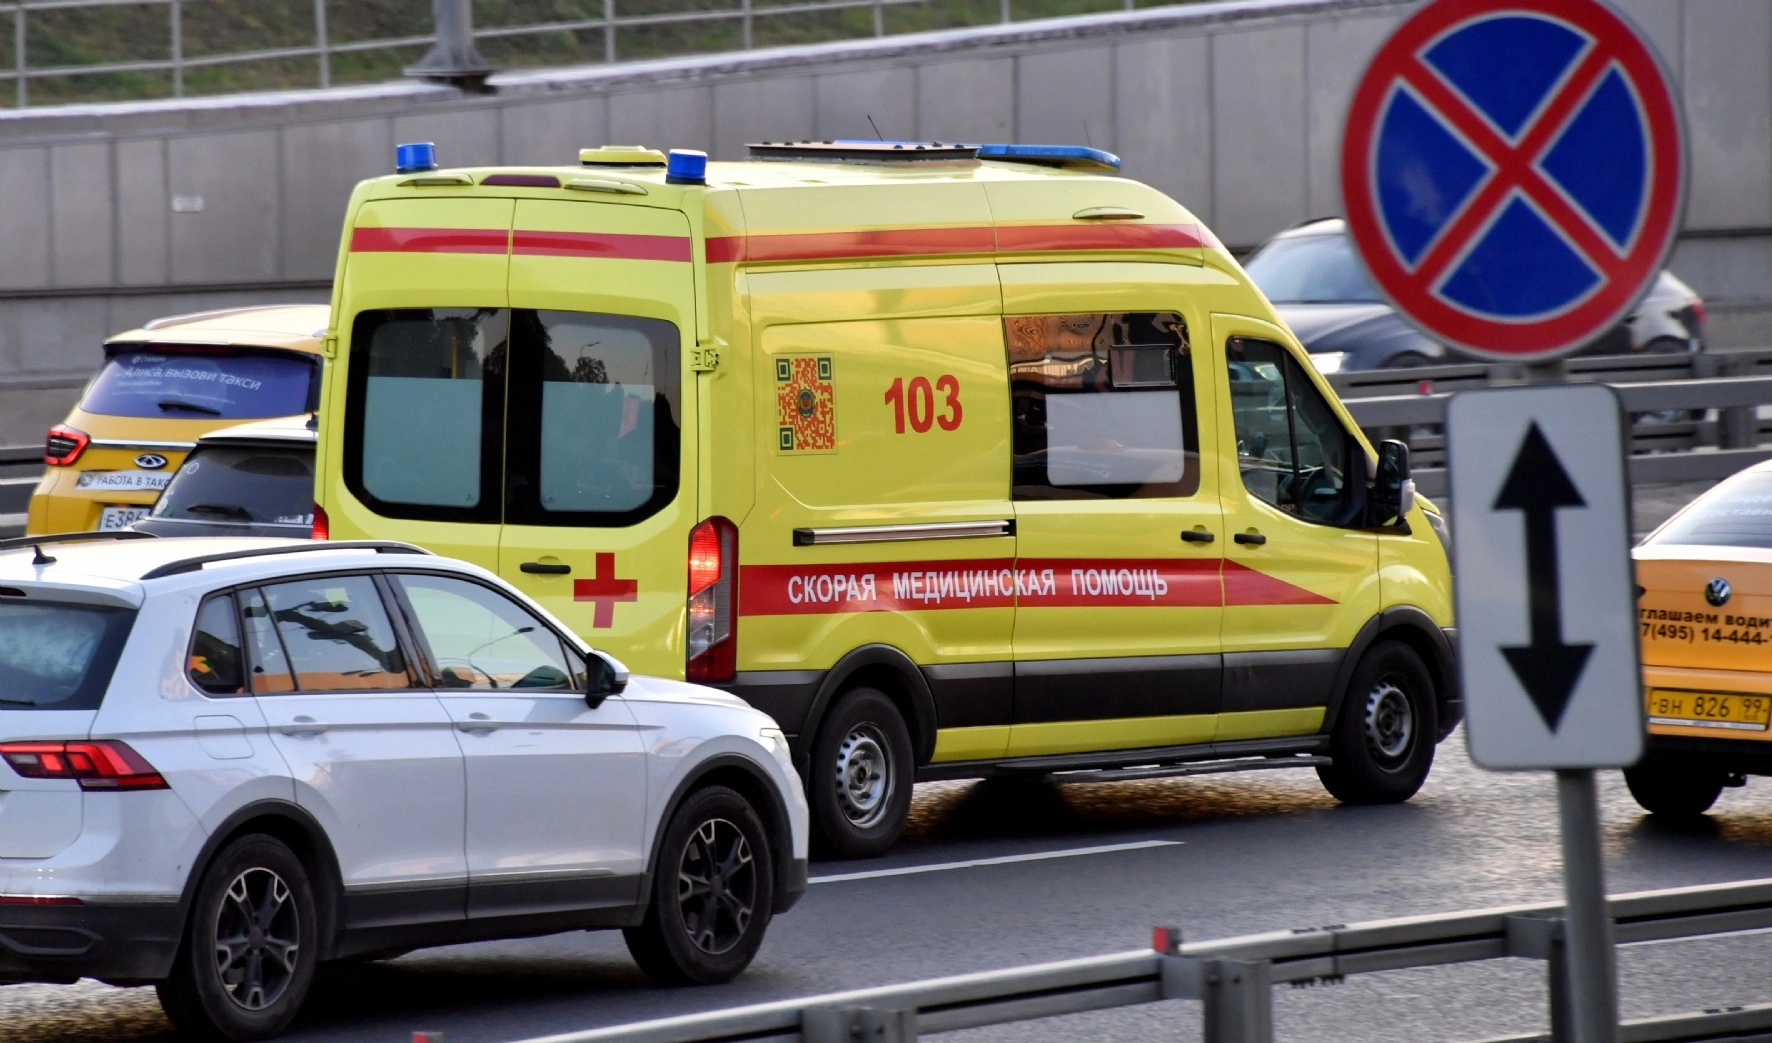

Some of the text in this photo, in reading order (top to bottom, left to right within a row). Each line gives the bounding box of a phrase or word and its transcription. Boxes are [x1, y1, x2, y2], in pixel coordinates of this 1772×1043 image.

[124, 366, 262, 391] Алиса, вызови такси
[884, 374, 963, 435] 103
[97, 475, 133, 486] РАБОТА
[136, 476, 143, 486] В
[787, 568, 1169, 604] СКОРАЯ МЕДИЦИНСКАЯ ПОМОЩЬ
[1640, 608, 1718, 624] глашаем
[1641, 622, 1695, 644] 7(495)
[1658, 696, 1762, 718] ВН 826 99
